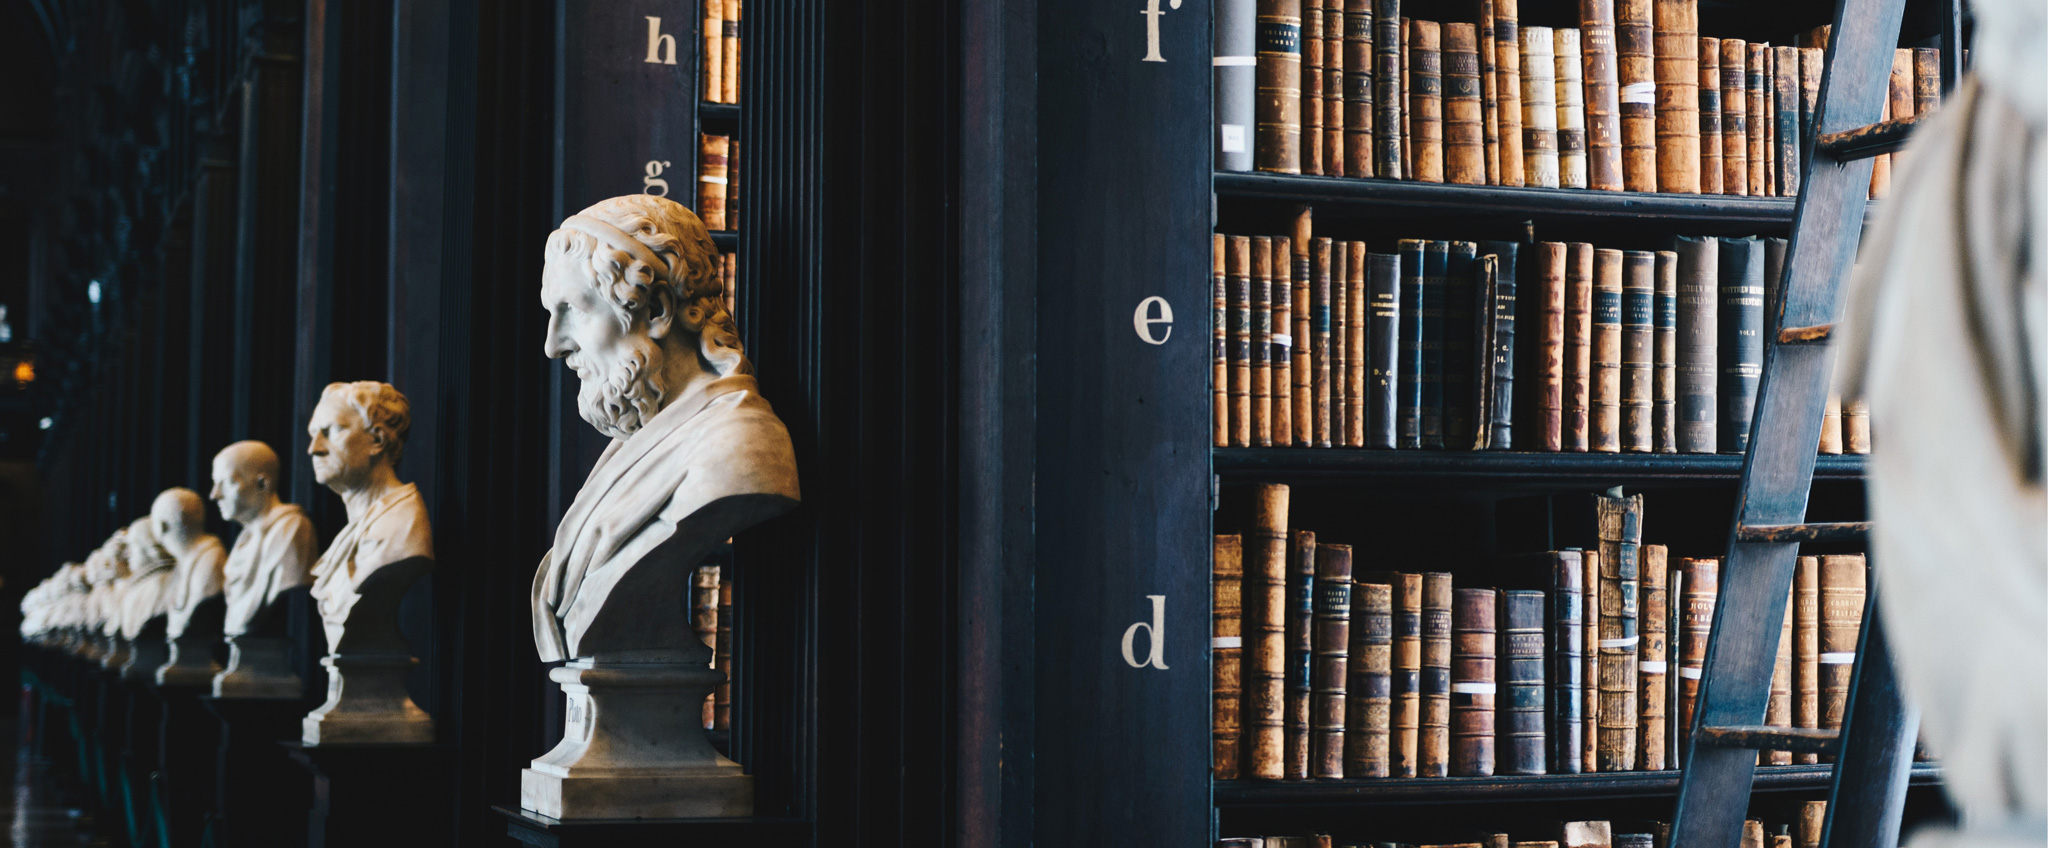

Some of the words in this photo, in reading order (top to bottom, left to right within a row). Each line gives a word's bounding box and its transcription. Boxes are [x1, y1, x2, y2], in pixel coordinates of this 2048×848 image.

[643, 15, 678, 66] h
[1140, 0, 1183, 62] f
[643, 160, 671, 197] g
[1134, 295, 1174, 346] e
[1686, 613, 1711, 623] BIBL
[1691, 602, 1714, 611] HOLY
[1122, 595, 1170, 670] d
